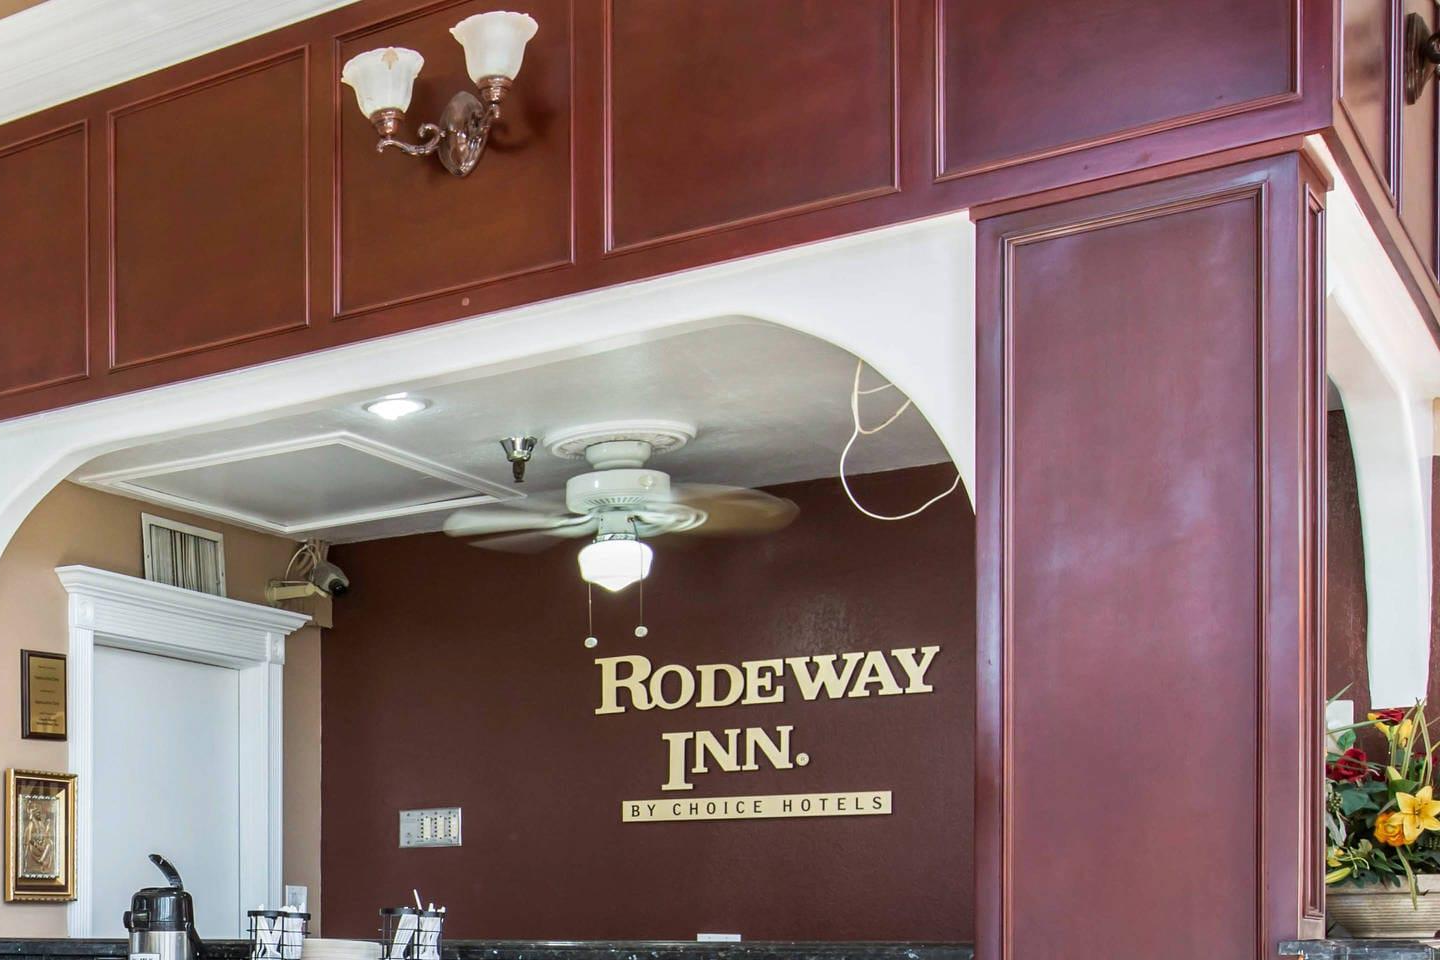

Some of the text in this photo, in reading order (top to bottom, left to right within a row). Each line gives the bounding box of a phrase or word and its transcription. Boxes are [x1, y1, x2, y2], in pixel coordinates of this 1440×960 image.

[594, 645, 940, 715] RODEWAY
[631, 796, 883, 818] BY CHOICE HOTELS
